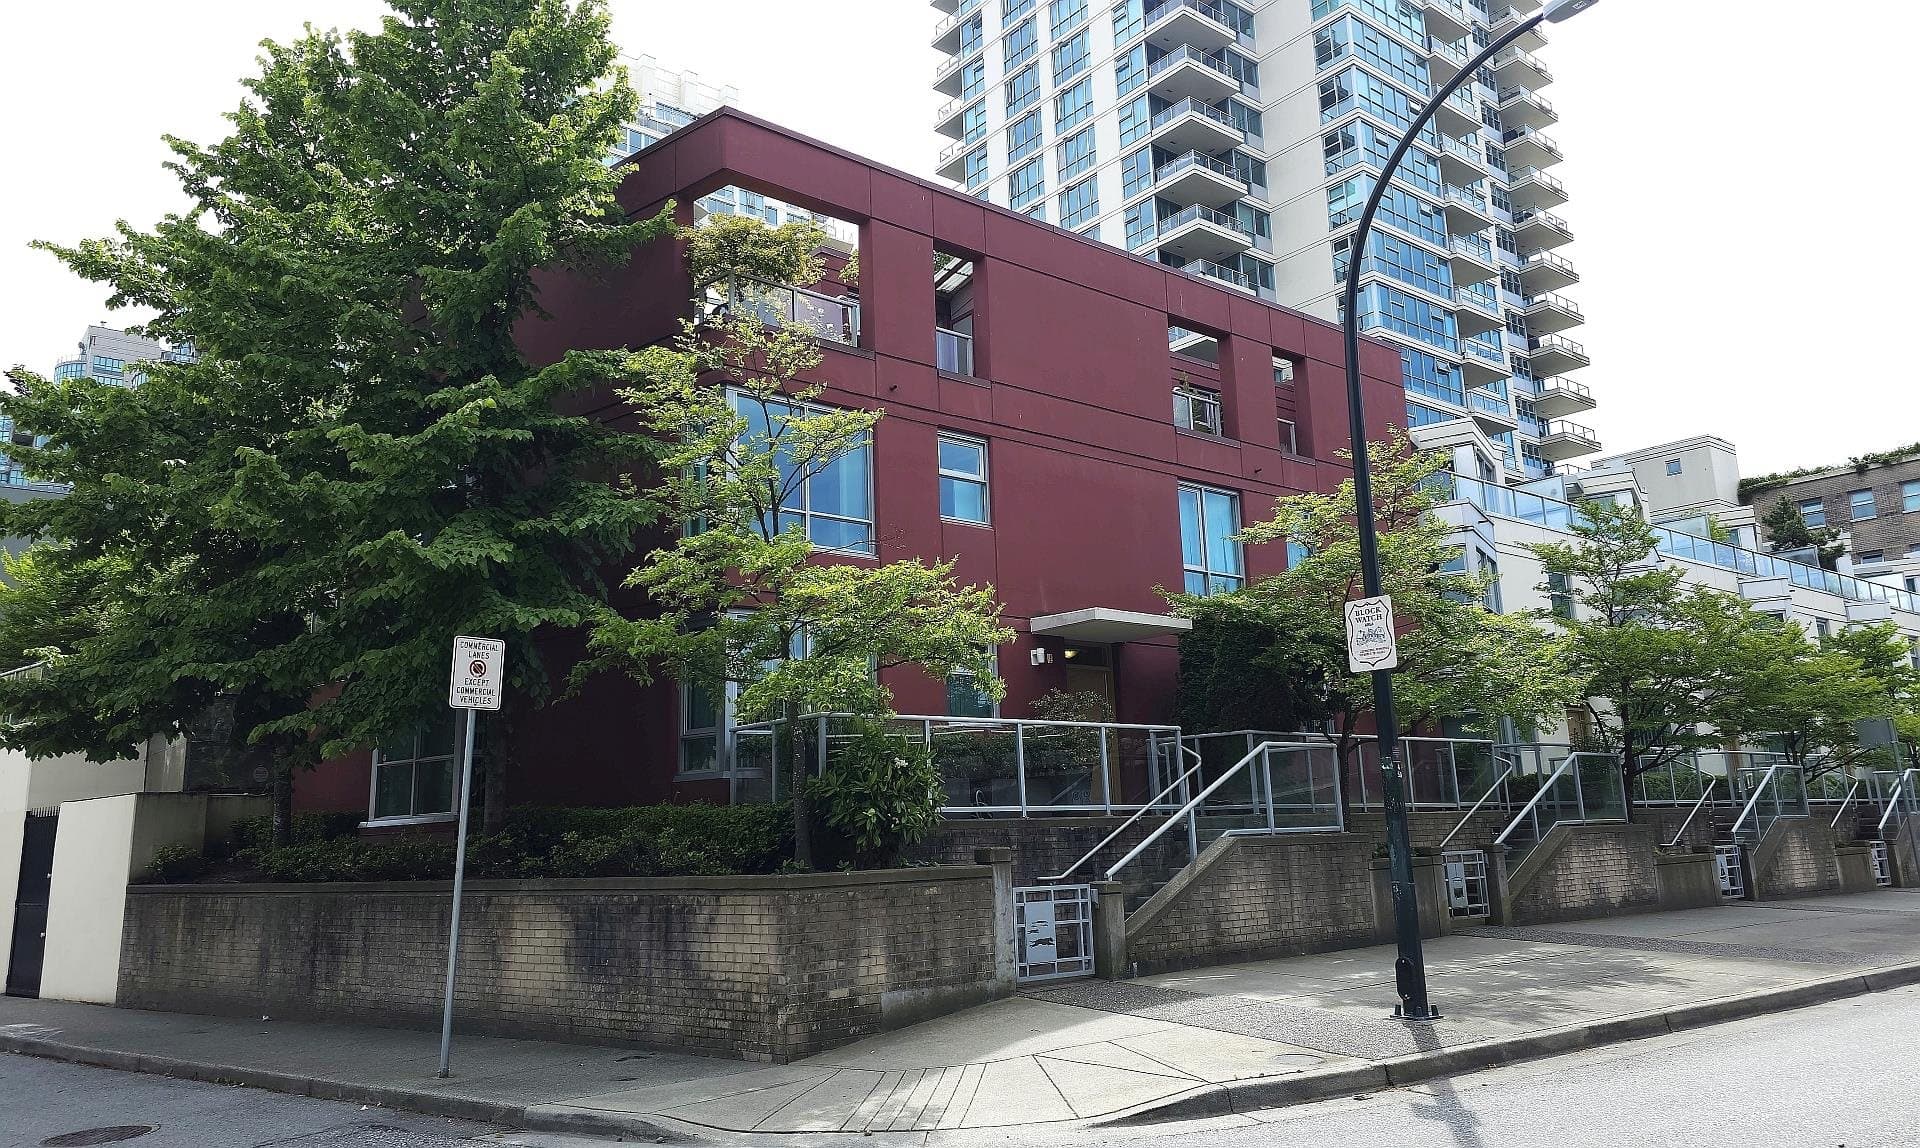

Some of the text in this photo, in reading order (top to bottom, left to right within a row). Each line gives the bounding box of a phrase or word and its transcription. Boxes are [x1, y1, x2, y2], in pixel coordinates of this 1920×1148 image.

[1354, 606, 1382, 616] BLOCK
[1355, 614, 1382, 623] WATCH
[468, 651, 490, 659] LANES
[465, 678, 490, 686] EXCEPT
[456, 686, 496, 696] COMMERCIAL
[460, 696, 492, 704] VEHICLES
